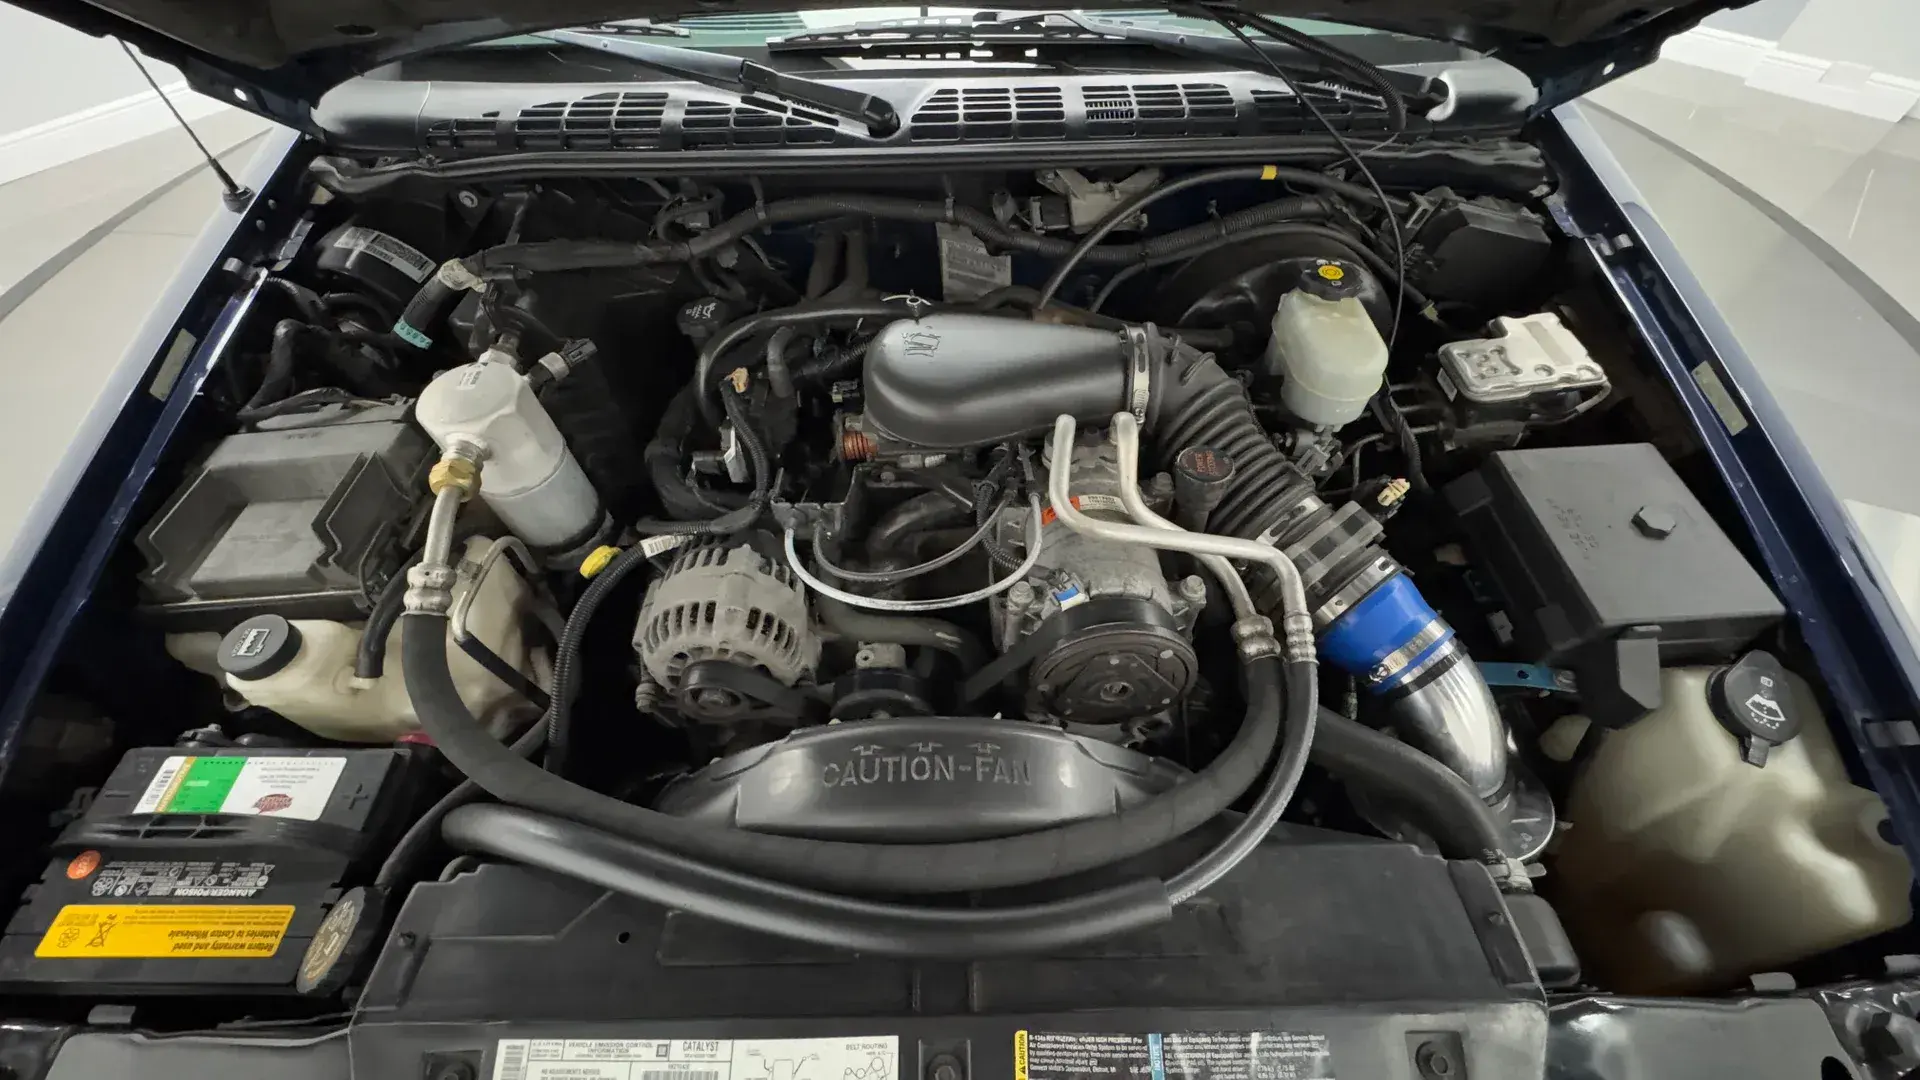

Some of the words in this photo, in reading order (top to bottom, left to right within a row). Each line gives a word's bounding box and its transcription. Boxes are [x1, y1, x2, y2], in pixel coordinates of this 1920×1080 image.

[193, 942, 210, 951] and
[210, 941, 247, 951] warranty
[247, 943, 274, 952] Return
[682, 1041, 719, 1052] CATALYST
